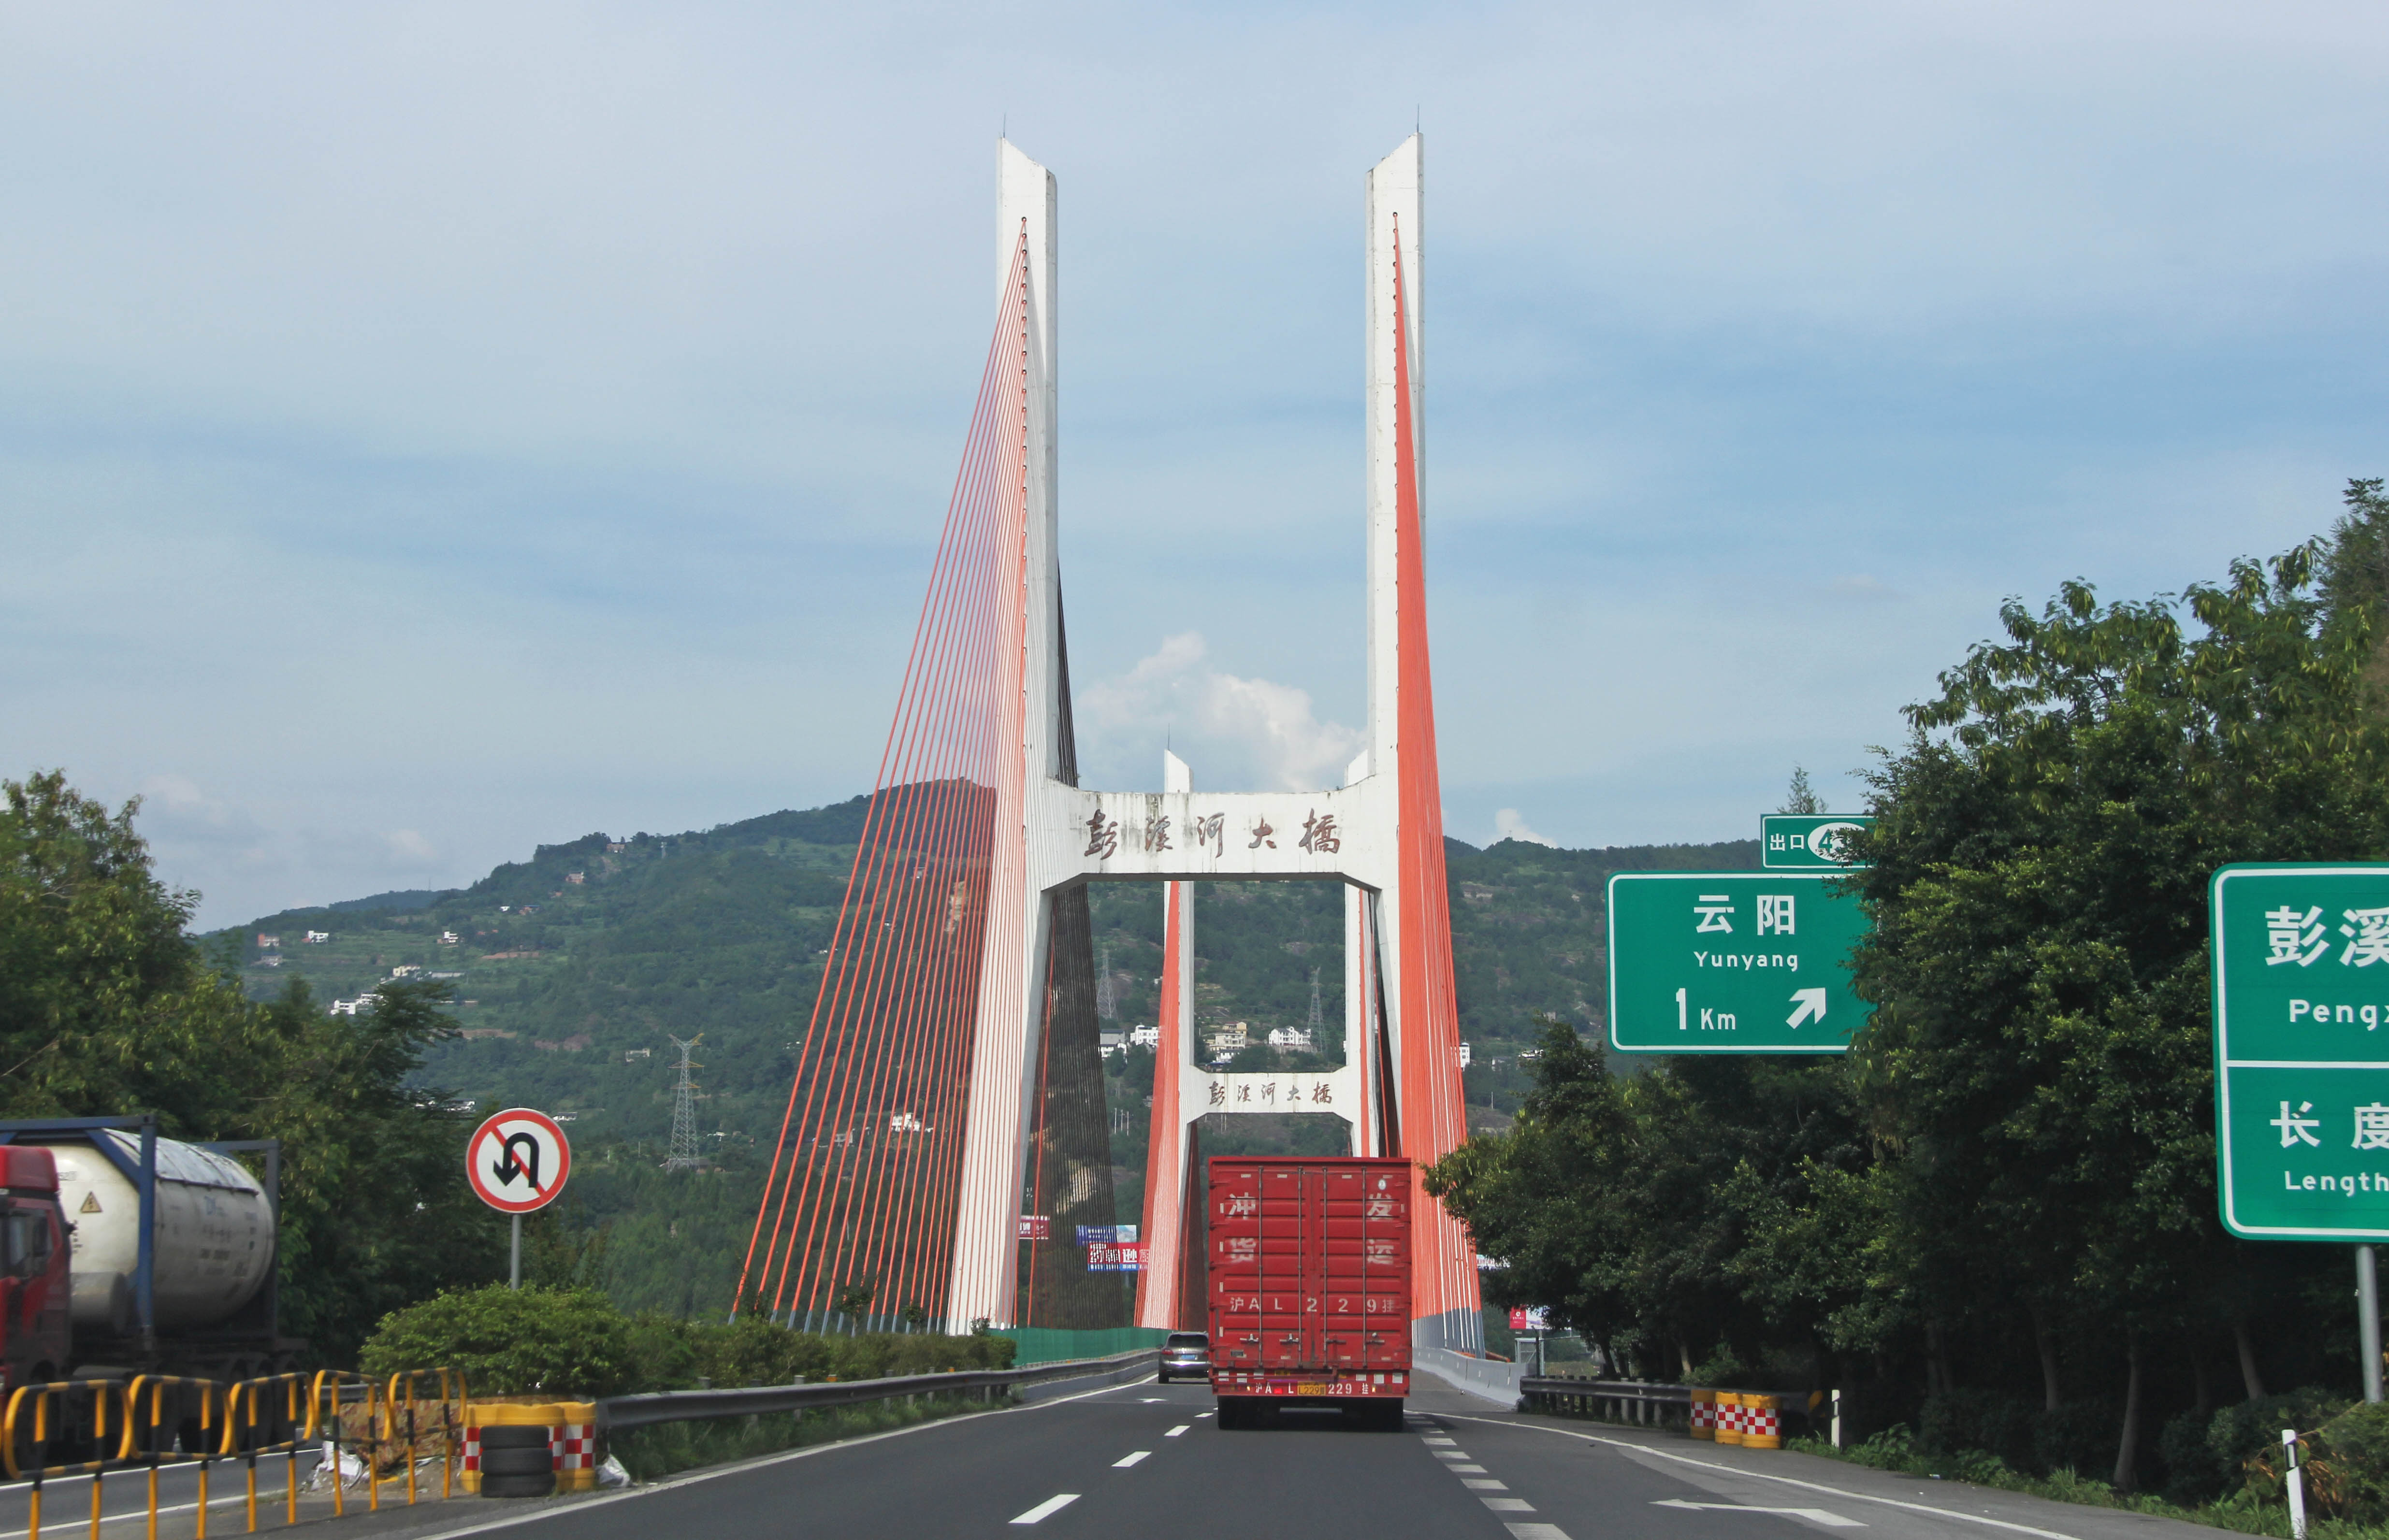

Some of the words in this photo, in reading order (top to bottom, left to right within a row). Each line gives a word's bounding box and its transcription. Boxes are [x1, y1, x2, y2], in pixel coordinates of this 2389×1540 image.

[1770, 834, 1804, 851] 出口
[1694, 895, 1795, 936] 云阳
[2265, 906, 2389, 967] 彭溪
[1694, 951, 1798, 971] Yunyang
[1676, 987, 1686, 1030] 1
[1700, 1008, 1736, 1030] Km
[2270, 1101, 2389, 1150] 长度
[2285, 1171, 2389, 1197] Length
[1367, 1193, 1393, 1221] 发
[1230, 1238, 1256, 1263] 货
[1367, 1238, 1394, 1264] 运
[1328, 1383, 1352, 1395] 229
